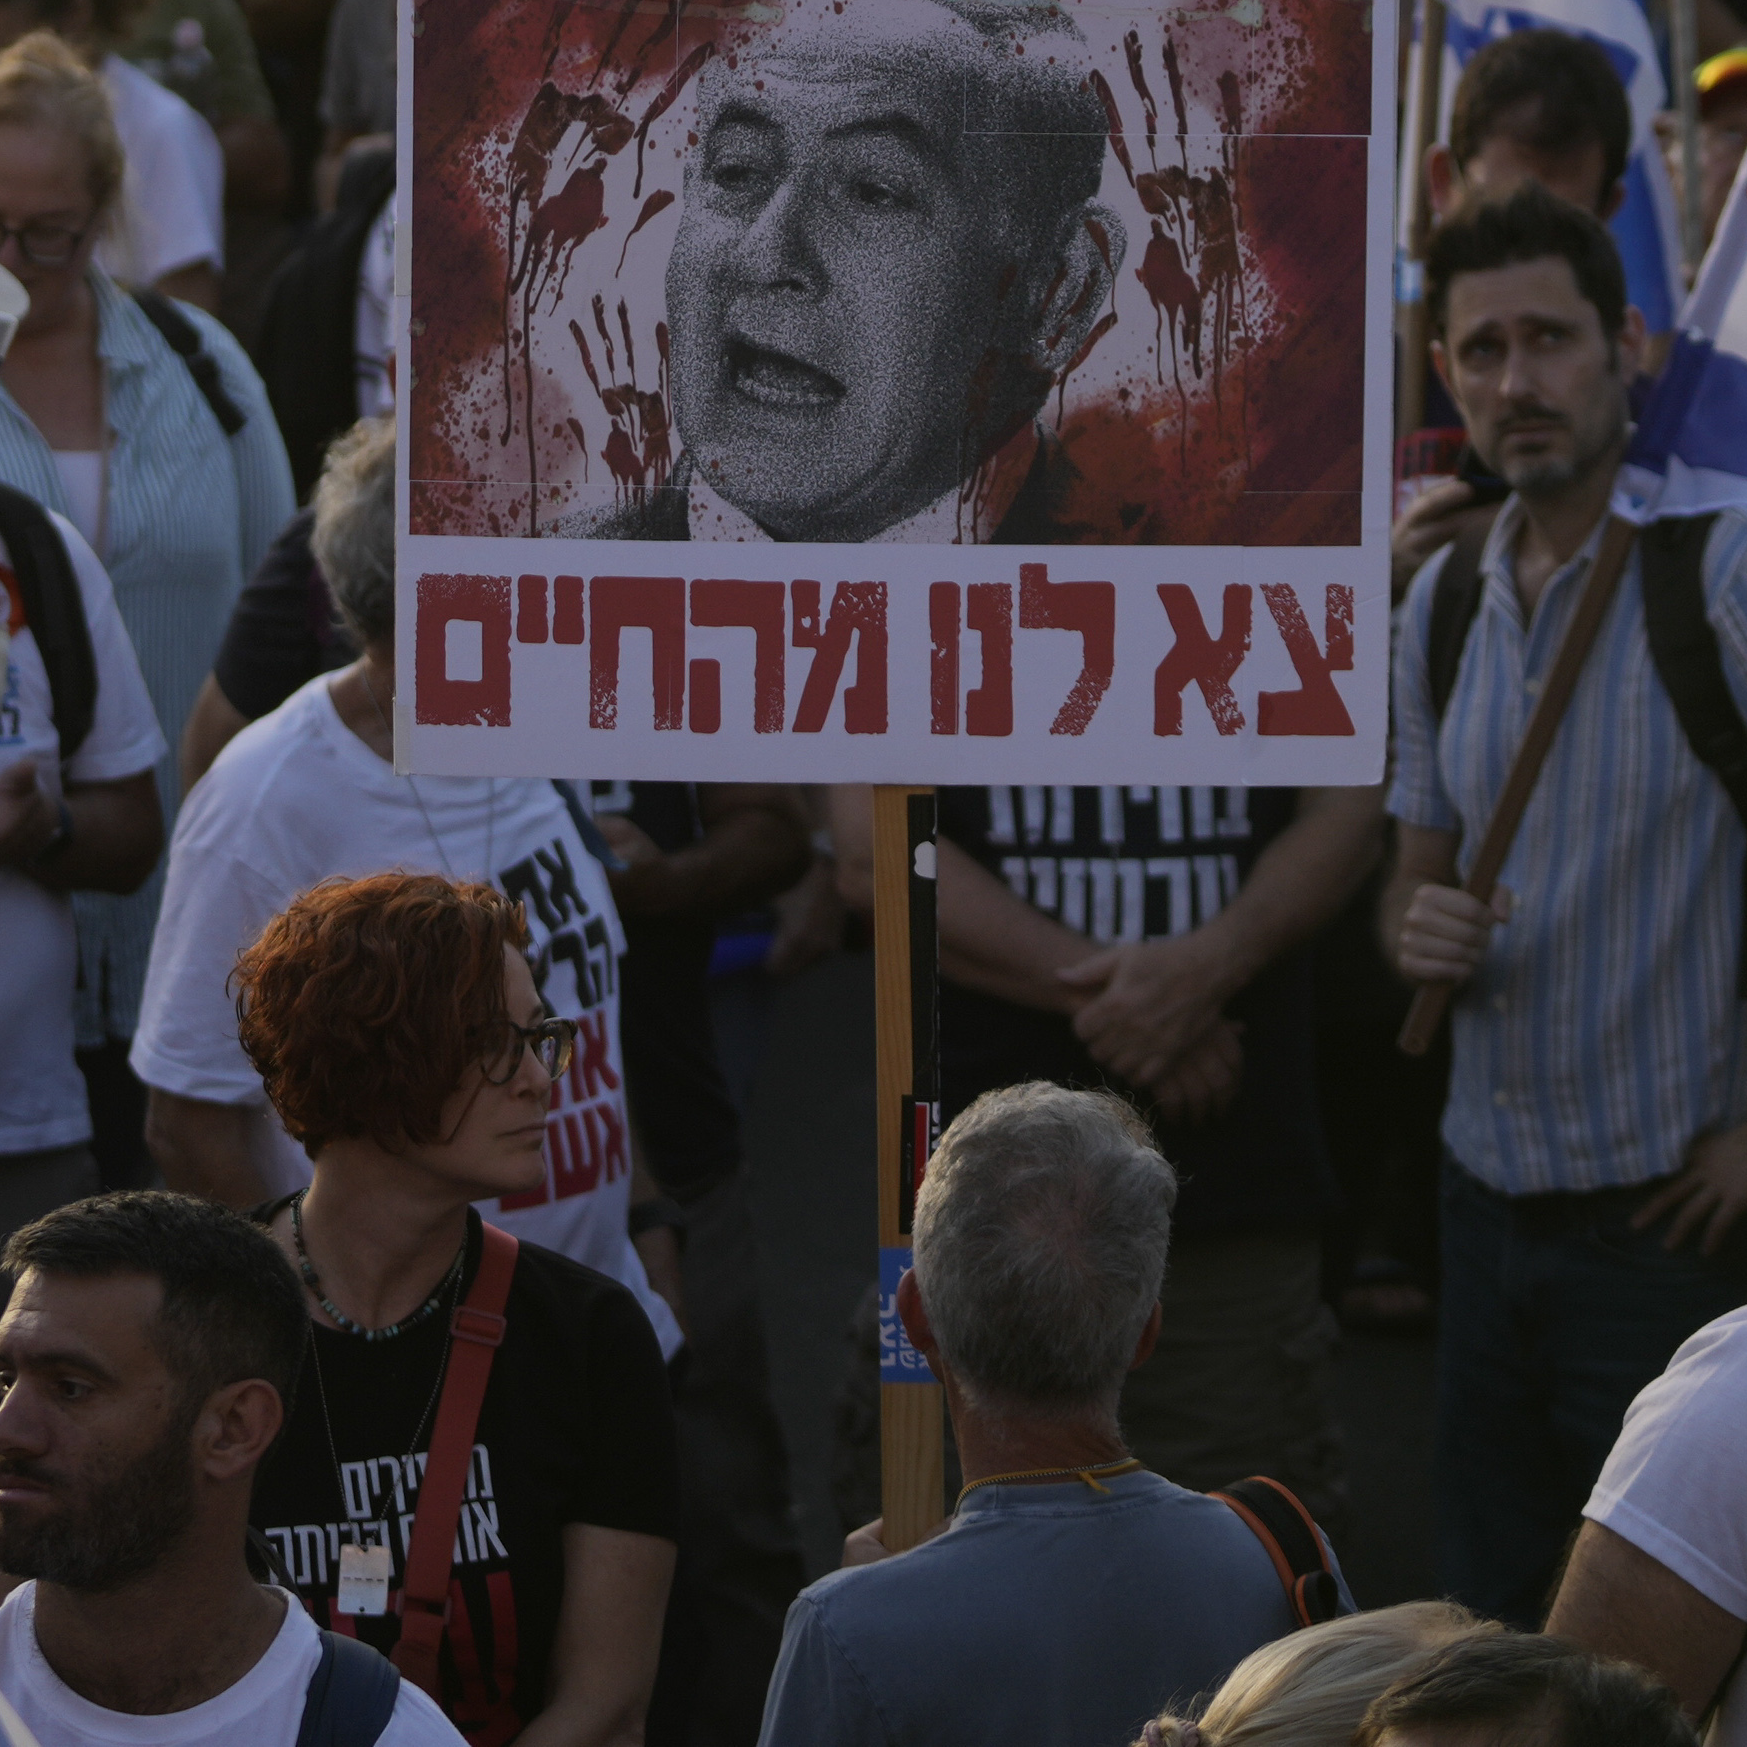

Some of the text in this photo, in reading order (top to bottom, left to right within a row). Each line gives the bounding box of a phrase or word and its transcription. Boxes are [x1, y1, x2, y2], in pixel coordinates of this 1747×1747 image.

[414, 561, 1355, 738] צא לנו מהחיים
[340, 1442, 495, 1520] מירים
